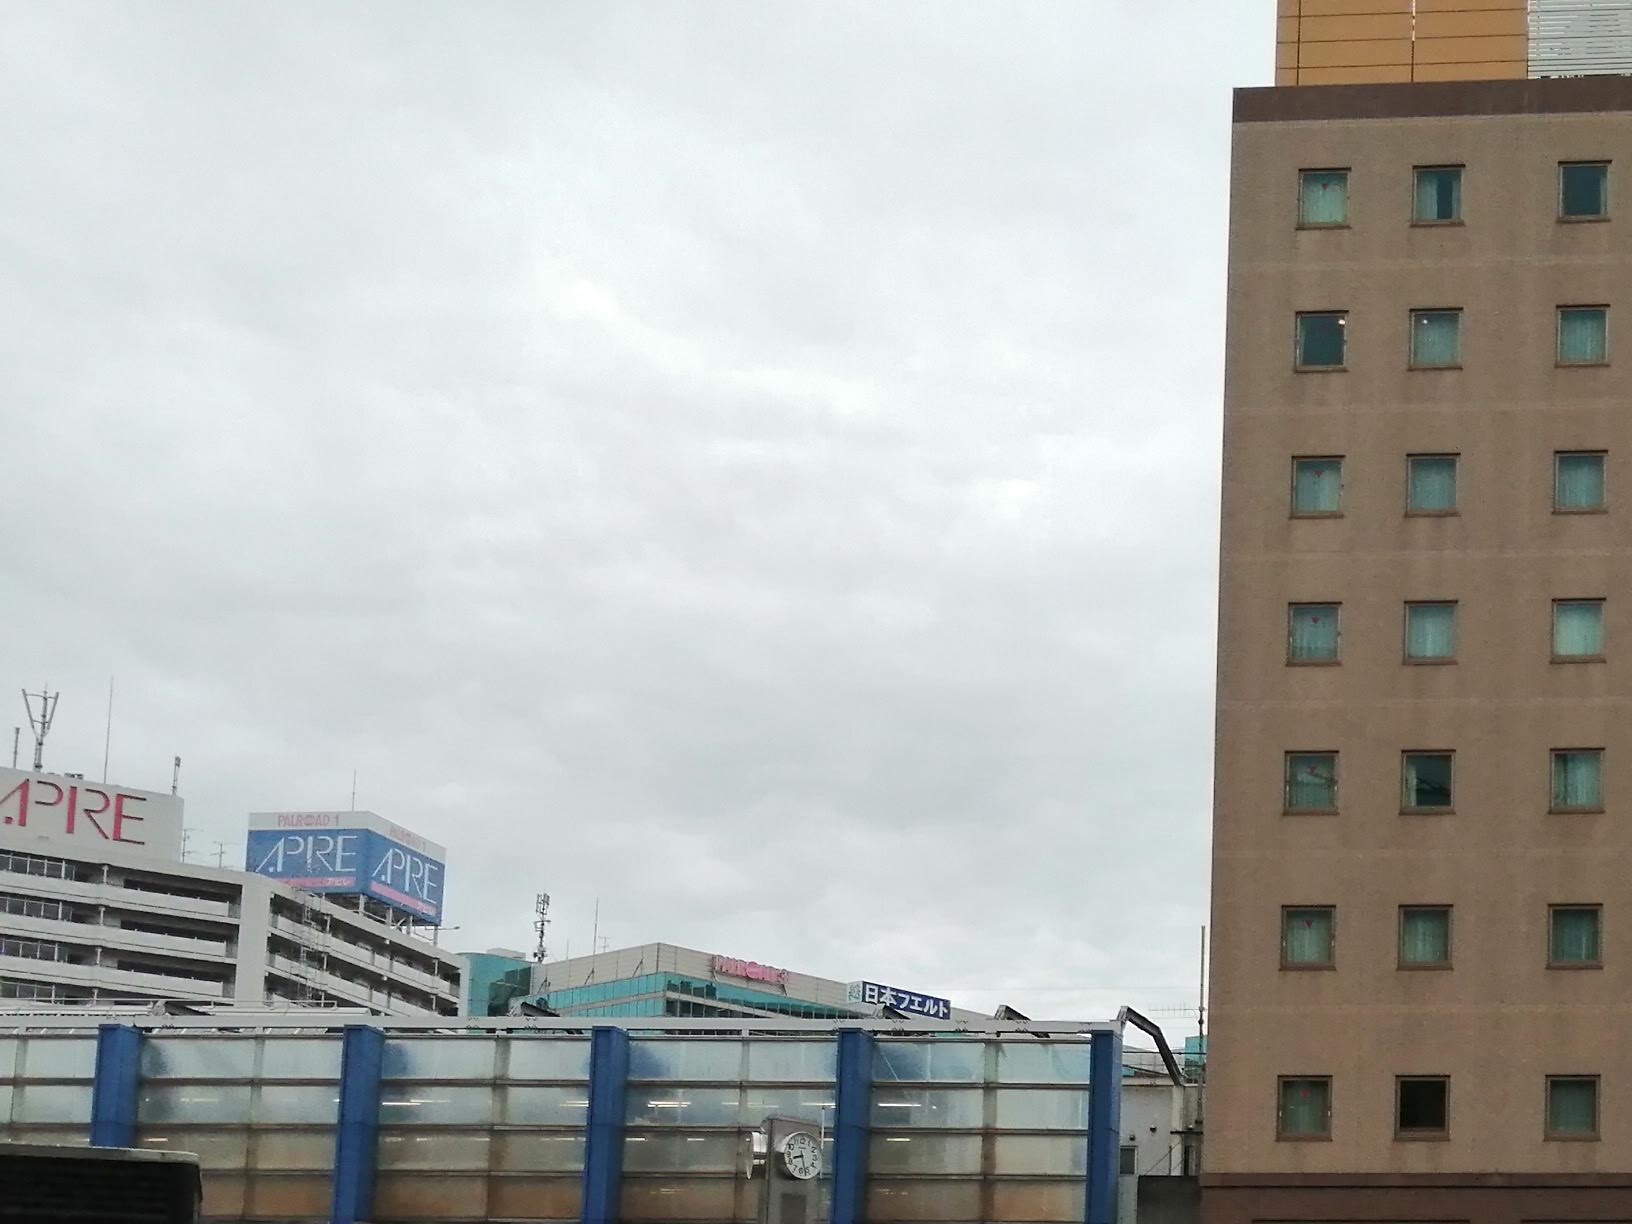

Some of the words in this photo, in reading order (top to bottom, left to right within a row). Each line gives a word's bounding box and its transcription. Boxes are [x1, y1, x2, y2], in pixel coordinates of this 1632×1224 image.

[865, 984, 949, 1018] 日本フエルト
